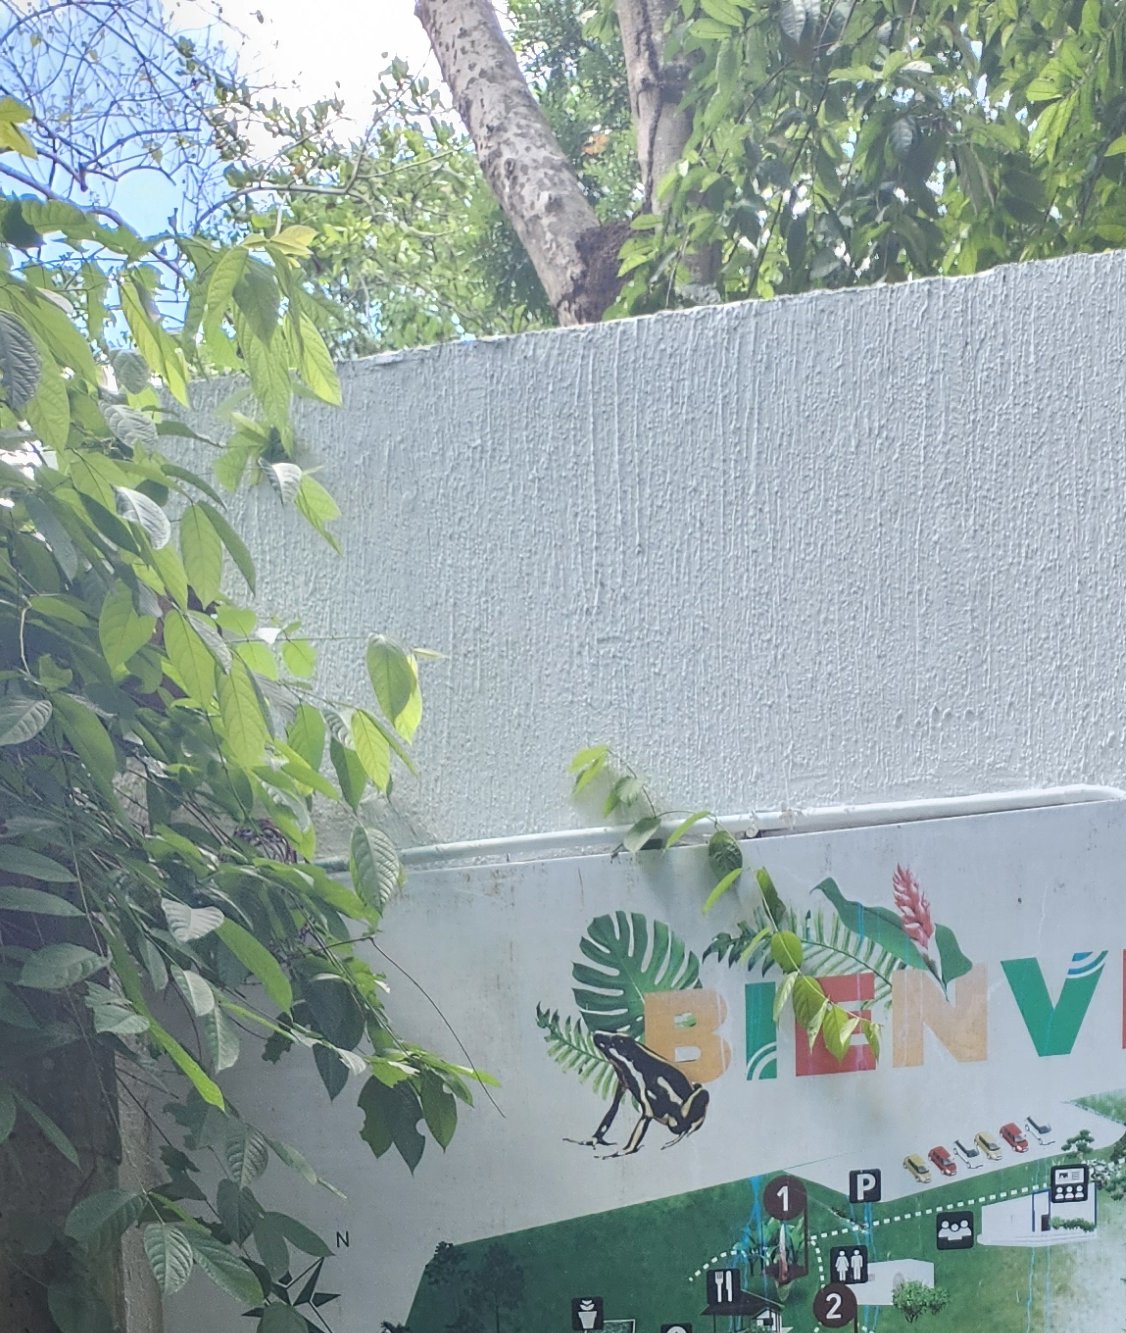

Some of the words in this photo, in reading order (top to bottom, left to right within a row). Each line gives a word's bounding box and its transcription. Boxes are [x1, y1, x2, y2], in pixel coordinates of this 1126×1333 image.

[857, 1173, 876, 1199] P
[777, 1186, 790, 1212] 1
[336, 1231, 350, 1248] N
[824, 1294, 842, 1319] 2
